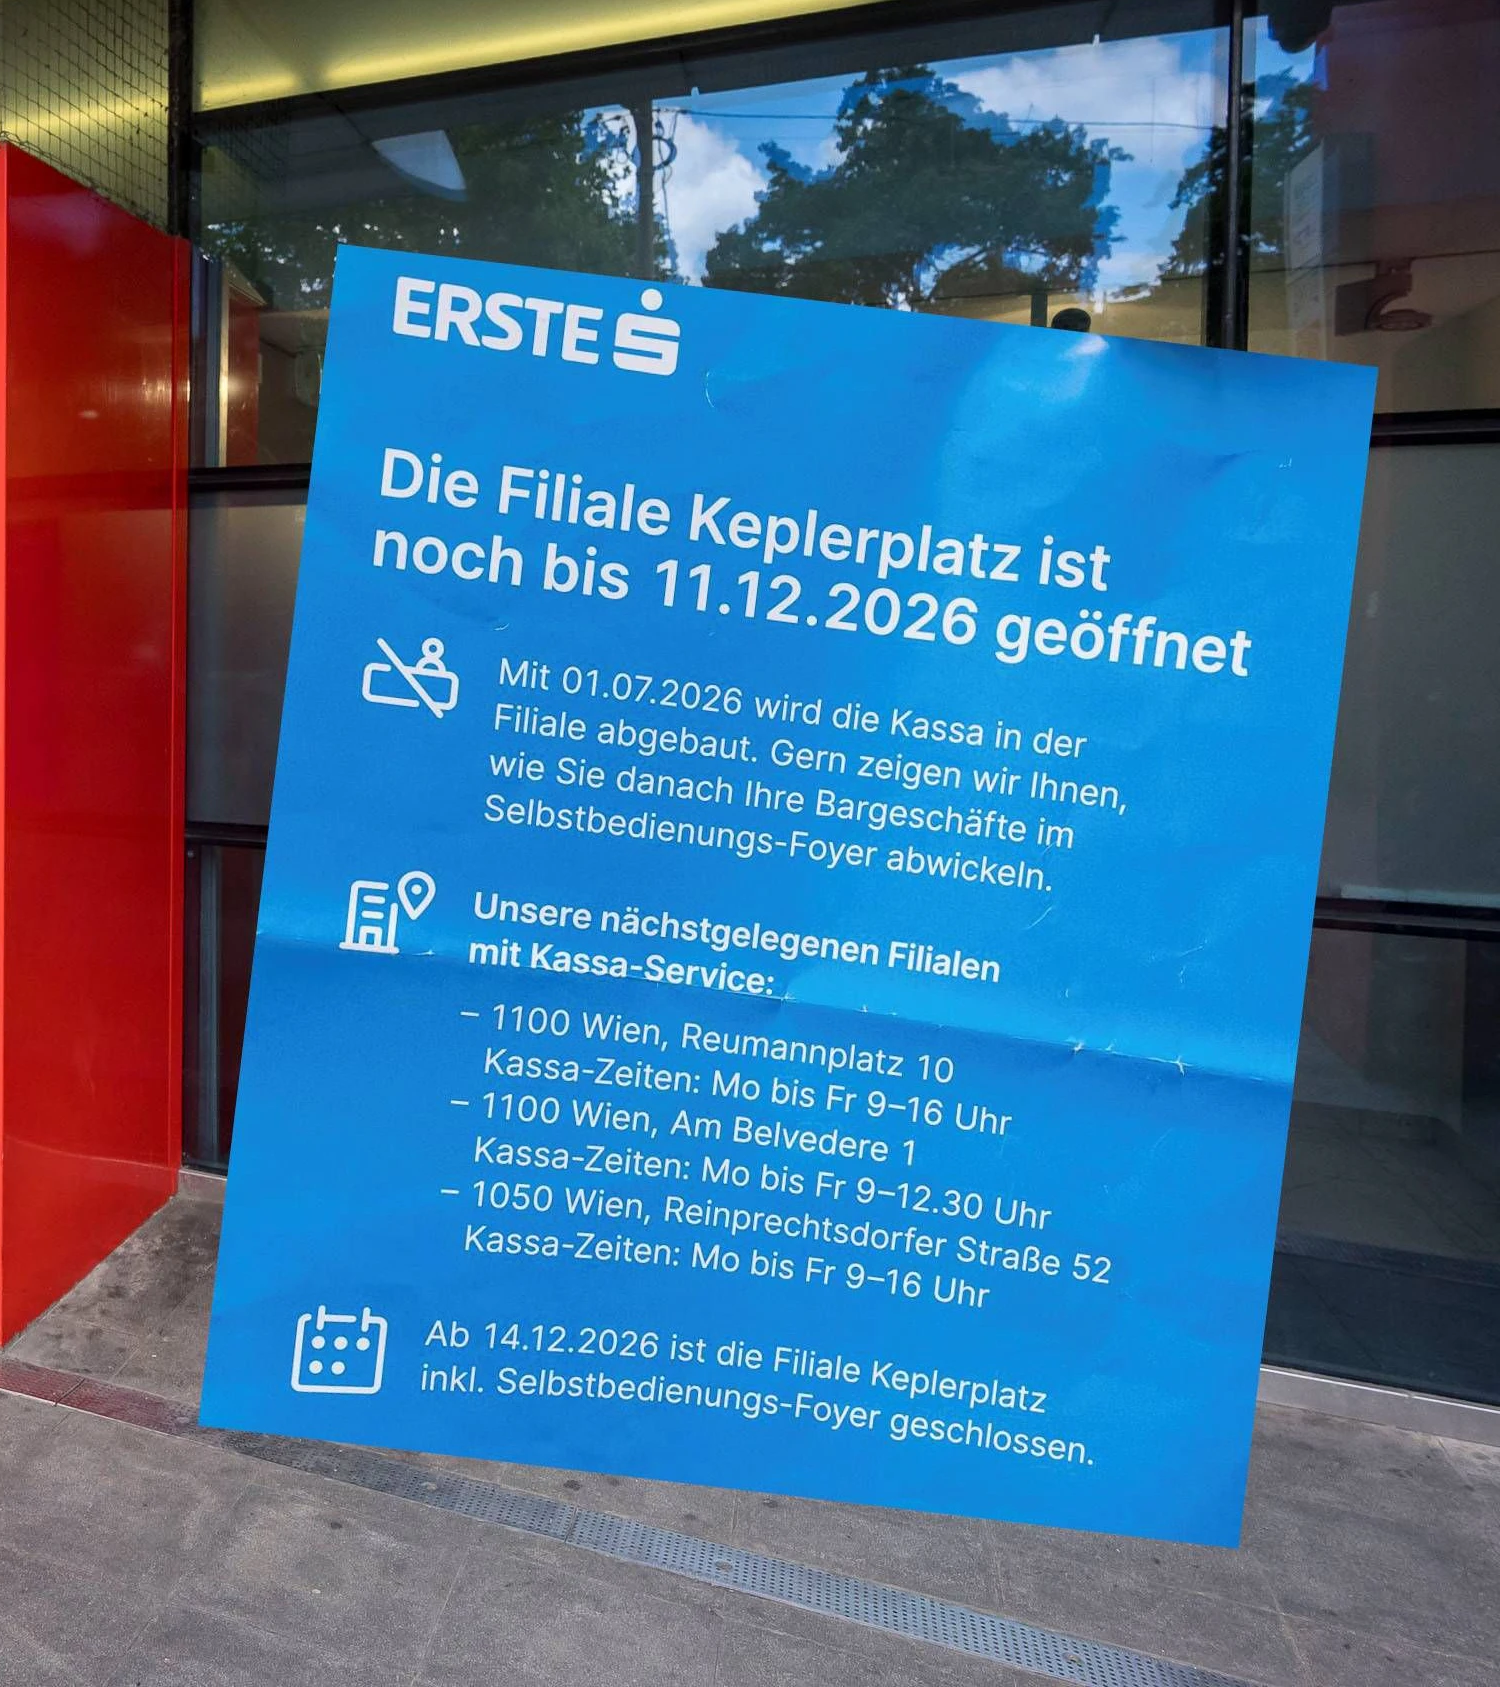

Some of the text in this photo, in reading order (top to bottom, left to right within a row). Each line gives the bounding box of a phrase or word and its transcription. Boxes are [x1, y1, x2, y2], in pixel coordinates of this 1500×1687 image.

[393, 276, 603, 364] ERSTE
[381, 448, 1111, 591] Die Filiale Keplerplatz ist
[373, 530, 1252, 677] noch bis 11.12.2026 geöffnet
[500, 658, 1087, 757] Mit 01.07.2026 wird die Kassa in der
[490, 752, 1073, 848] wie Sie danach Ihre Bargeschäfte im
[495, 703, 1126, 815] Filiale abgebaut. Gern zeigen wir Ihnen,
[485, 794, 1051, 891] Selbstbedienungs-Foyer abwickeln.
[469, 938, 774, 995] mit Kassa-Service:
[474, 892, 1000, 982] Unsere nächstgelegenen Filialen
[494, 1004, 569, 1036] 1100
[583, 1012, 667, 1051] Wien,
[682, 1023, 903, 1076] Reumannplatz
[919, 1055, 953, 1083] 10
[484, 1092, 559, 1124] 1100
[573, 1100, 657, 1138] Wien,
[671, 1110, 721, 1139] Am
[733, 1116, 888, 1161] Belvedere
[904, 1140, 914, 1165] 1
[485, 1048, 700, 1093] Kassa-Zeiten:
[713, 1070, 760, 1100] Mo
[772, 1077, 815, 1107] bis
[827, 1085, 857, 1112] Fr
[956, 1103, 1012, 1135] Uhr
[475, 1136, 690, 1179] Kassa-Zeiten:
[702, 1156, 749, 1186] Mo
[761, 1164, 804, 1194] bis
[816, 1172, 846, 1199] Fr
[995, 1197, 1052, 1229] Uhr
[465, 1225, 679, 1266] Kassa-Zeiten:
[692, 1243, 739, 1272] Mo
[751, 1250, 794, 1279] bis
[806, 1257, 836, 1284] Fr
[934, 1276, 990, 1308] Uhr
[474, 1181, 552, 1211] 1050
[566, 1188, 650, 1225] Wien,
[665, 1196, 947, 1257] Reinprechtsdorfer
[957, 1236, 1060, 1275] Straße
[1073, 1253, 1111, 1284] 52
[425, 1320, 1047, 1413] Ab 14.12.2026 ist die Filiale Keplerplatz
[422, 1364, 1093, 1465] inkl. Selbstbedienungs-Foyer geschlossen.
